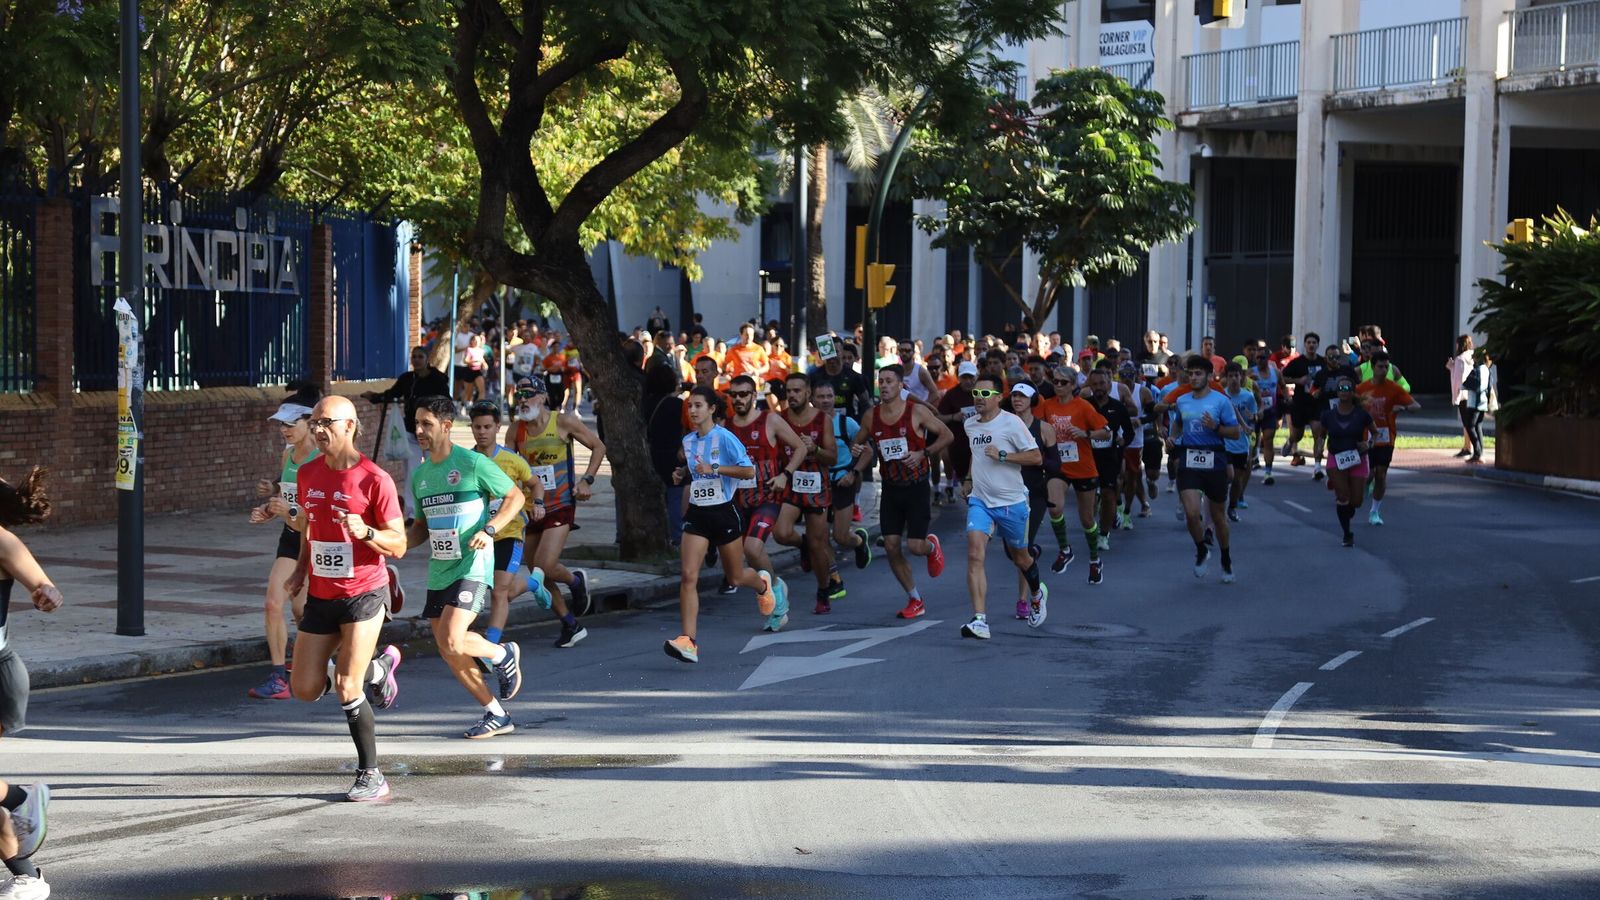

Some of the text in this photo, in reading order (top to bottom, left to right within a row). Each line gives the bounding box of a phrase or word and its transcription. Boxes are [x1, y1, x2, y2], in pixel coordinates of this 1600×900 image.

[1099, 29, 1147, 44] CORNER VIP
[1099, 43, 1146, 56] MALAGUISTA
[972, 433, 993, 446] nike
[884, 445, 903, 455] 755
[1193, 455, 1206, 464] 40
[796, 478, 816, 488] 787
[693, 487, 716, 499] 938
[421, 493, 455, 507] ATLETISMO
[432, 540, 454, 551] 362
[315, 553, 344, 567] 882
